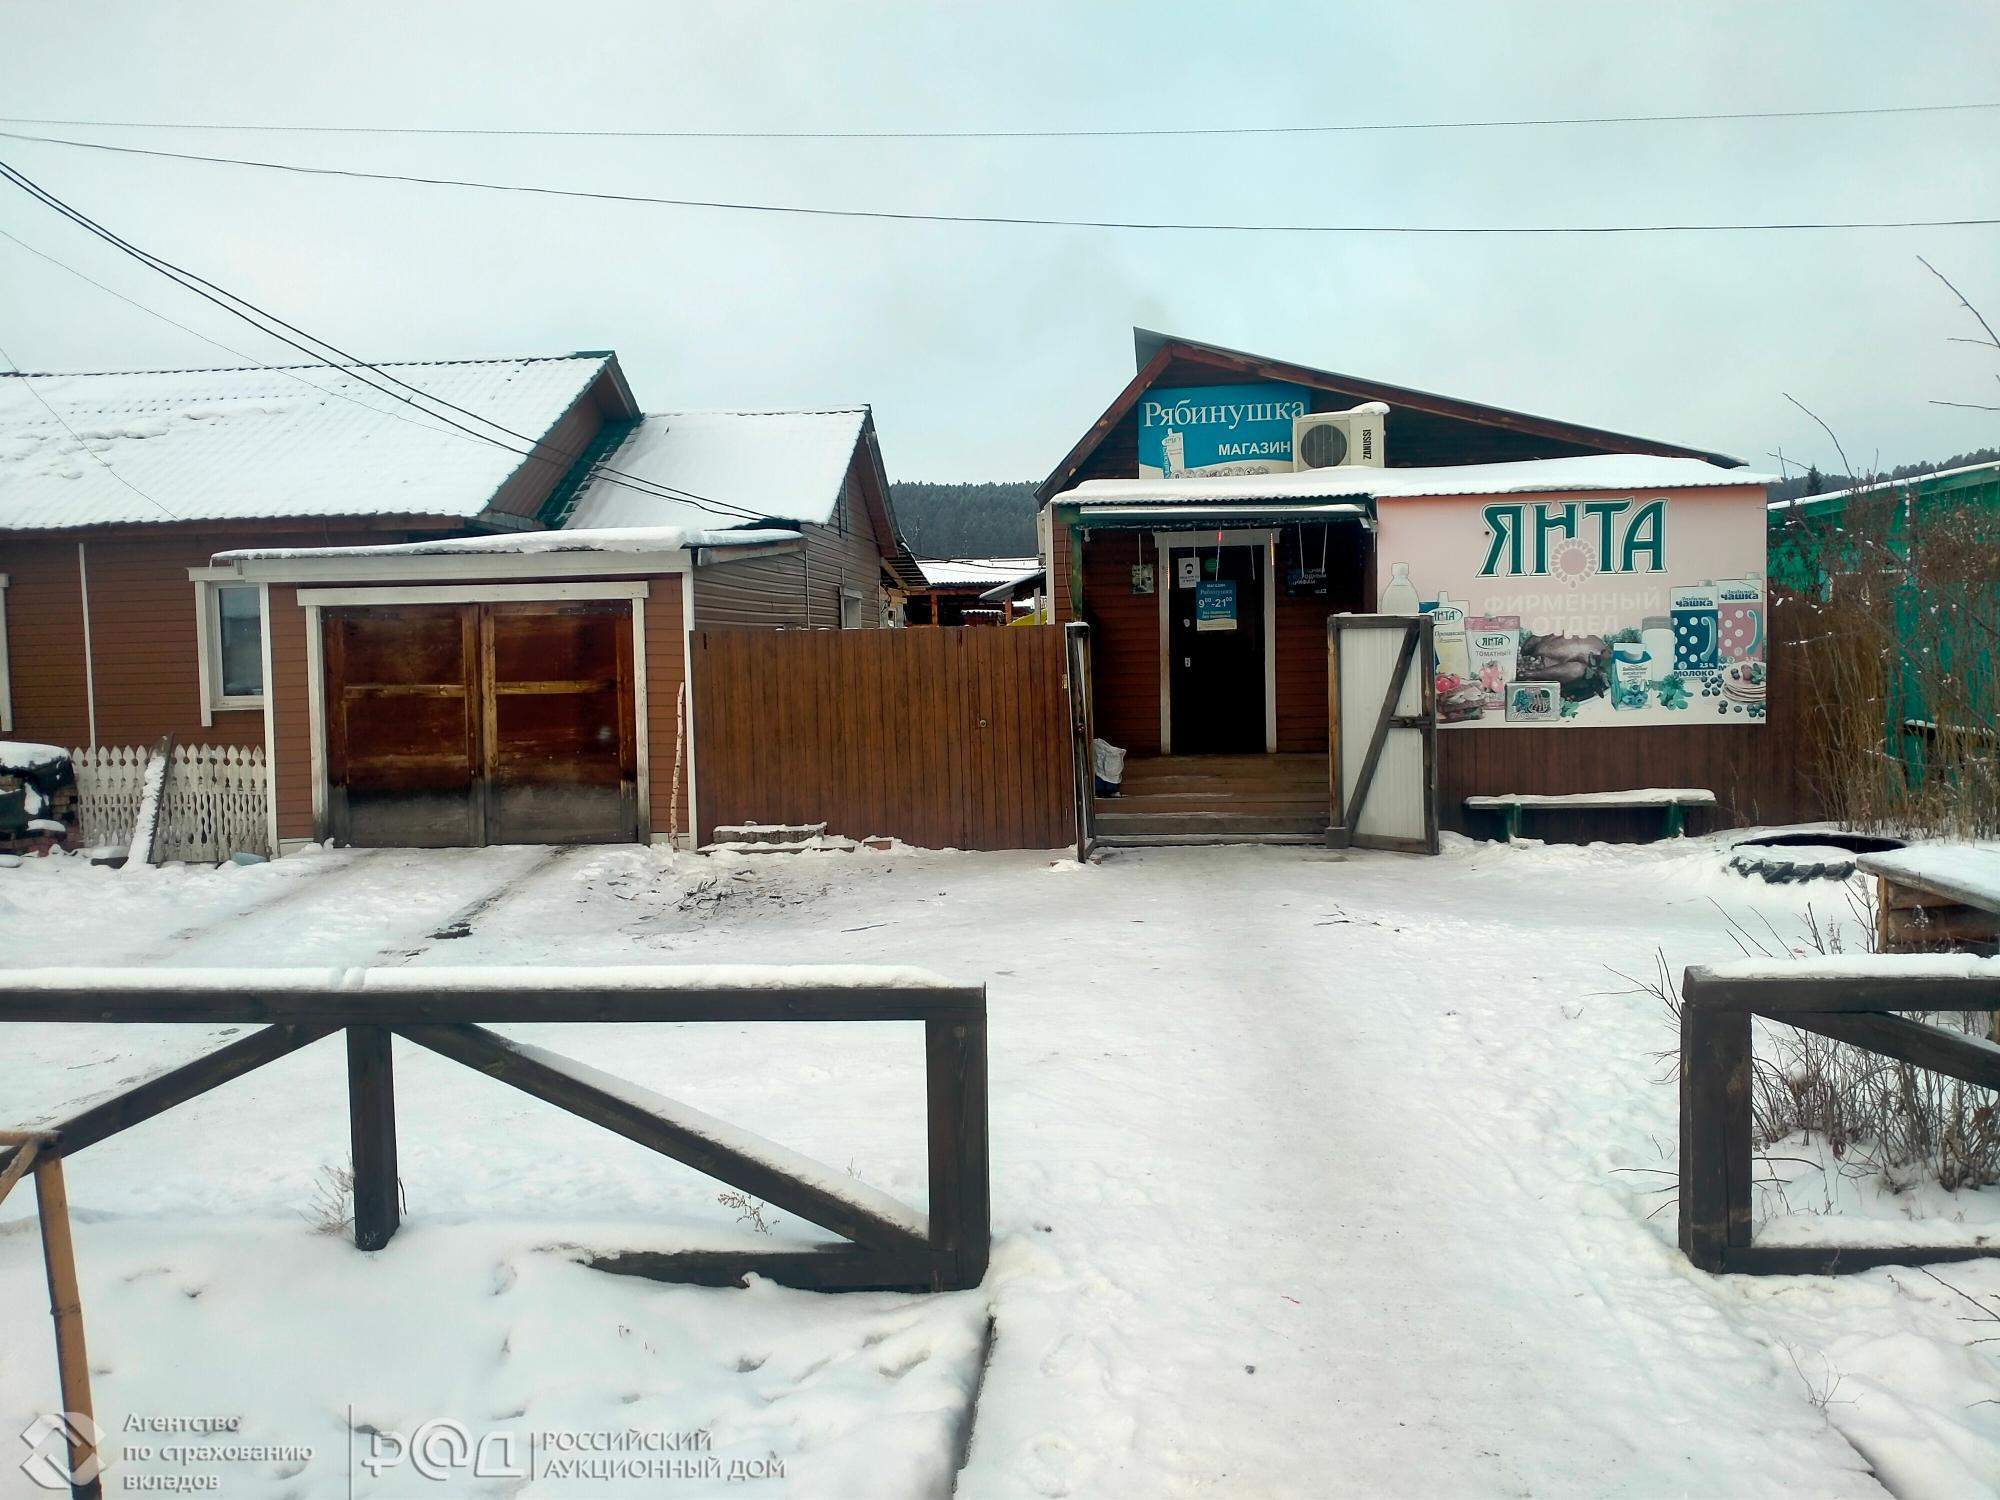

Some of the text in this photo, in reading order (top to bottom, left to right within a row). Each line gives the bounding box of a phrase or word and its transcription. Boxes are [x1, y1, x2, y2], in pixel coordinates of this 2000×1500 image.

[1143, 399, 1305, 430] Рябинушка
[1218, 441, 1291, 456] МАГАЗИН
[1362, 429, 1372, 460] ZANUSSI
[1475, 497, 1671, 579] ЯНТА
[1484, 586, 1663, 613] ФИРМЕННЫЙ
[1533, 615, 1617, 639] ОТДЕЛ
